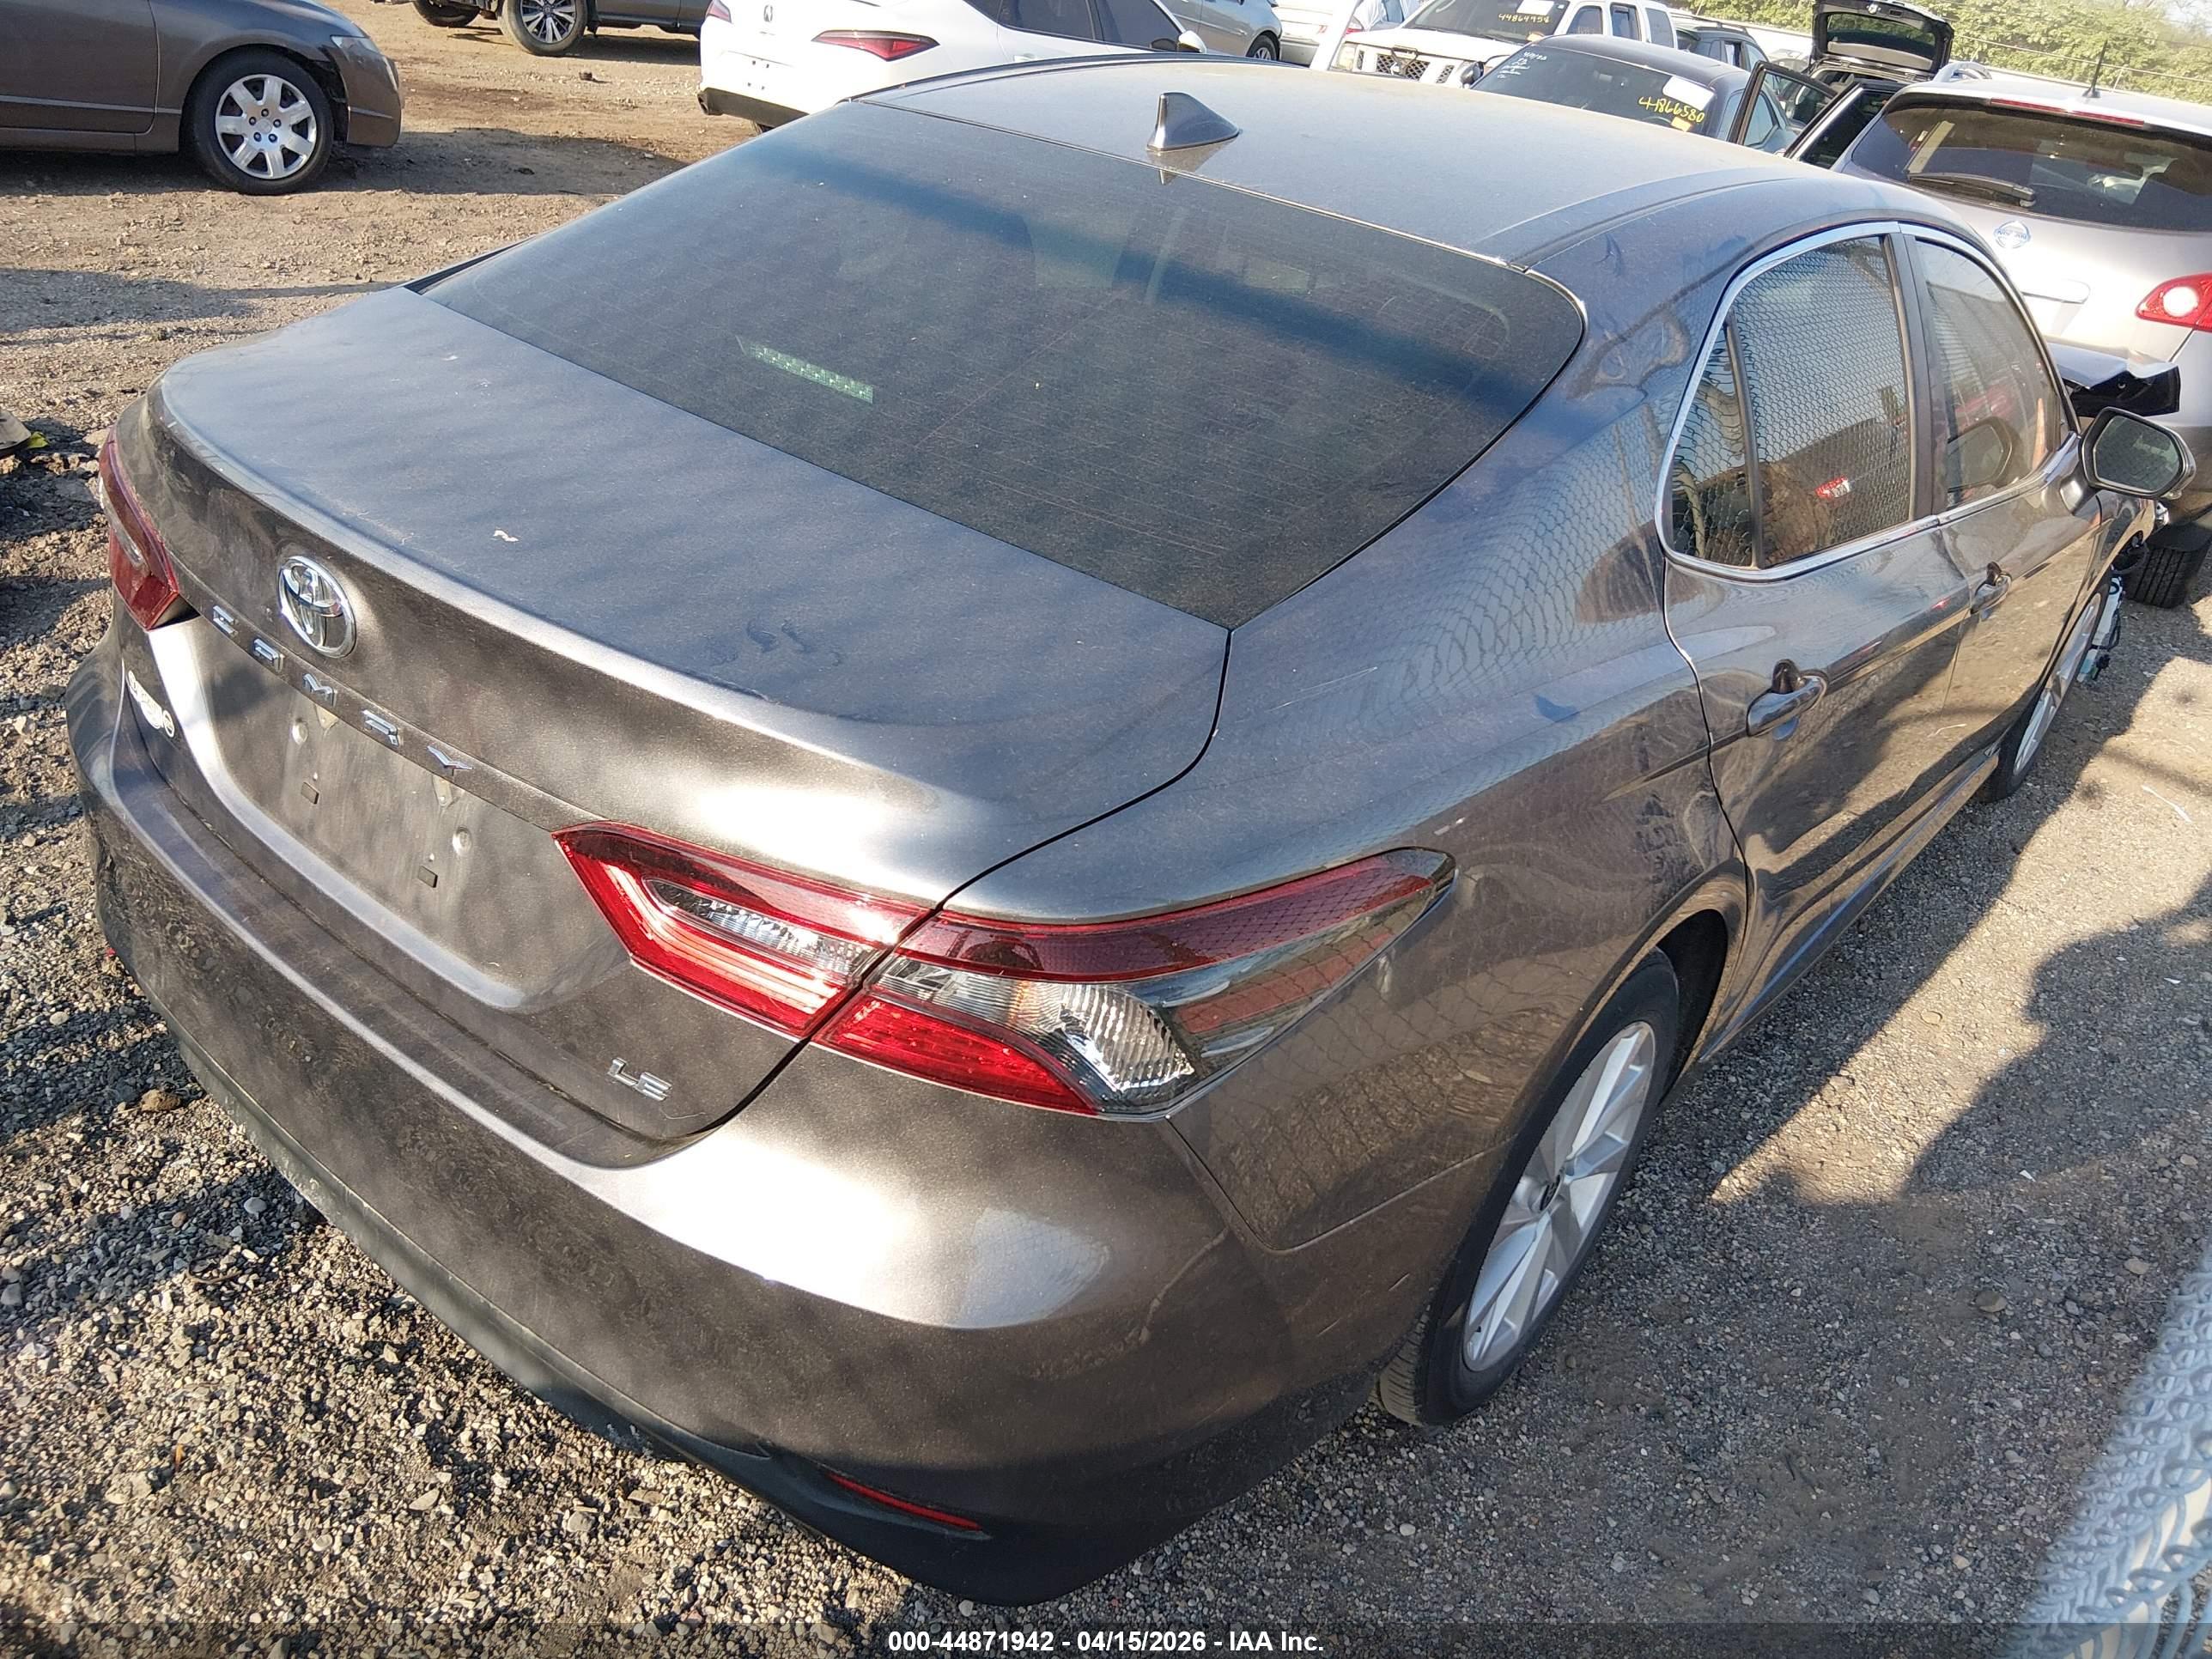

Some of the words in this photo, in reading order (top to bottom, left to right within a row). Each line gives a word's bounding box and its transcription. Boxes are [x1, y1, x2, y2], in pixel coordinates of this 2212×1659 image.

[1638, 96, 1705, 123] 44866580
[212, 605, 475, 775] CAMRY
[608, 1057, 673, 1102] LE
